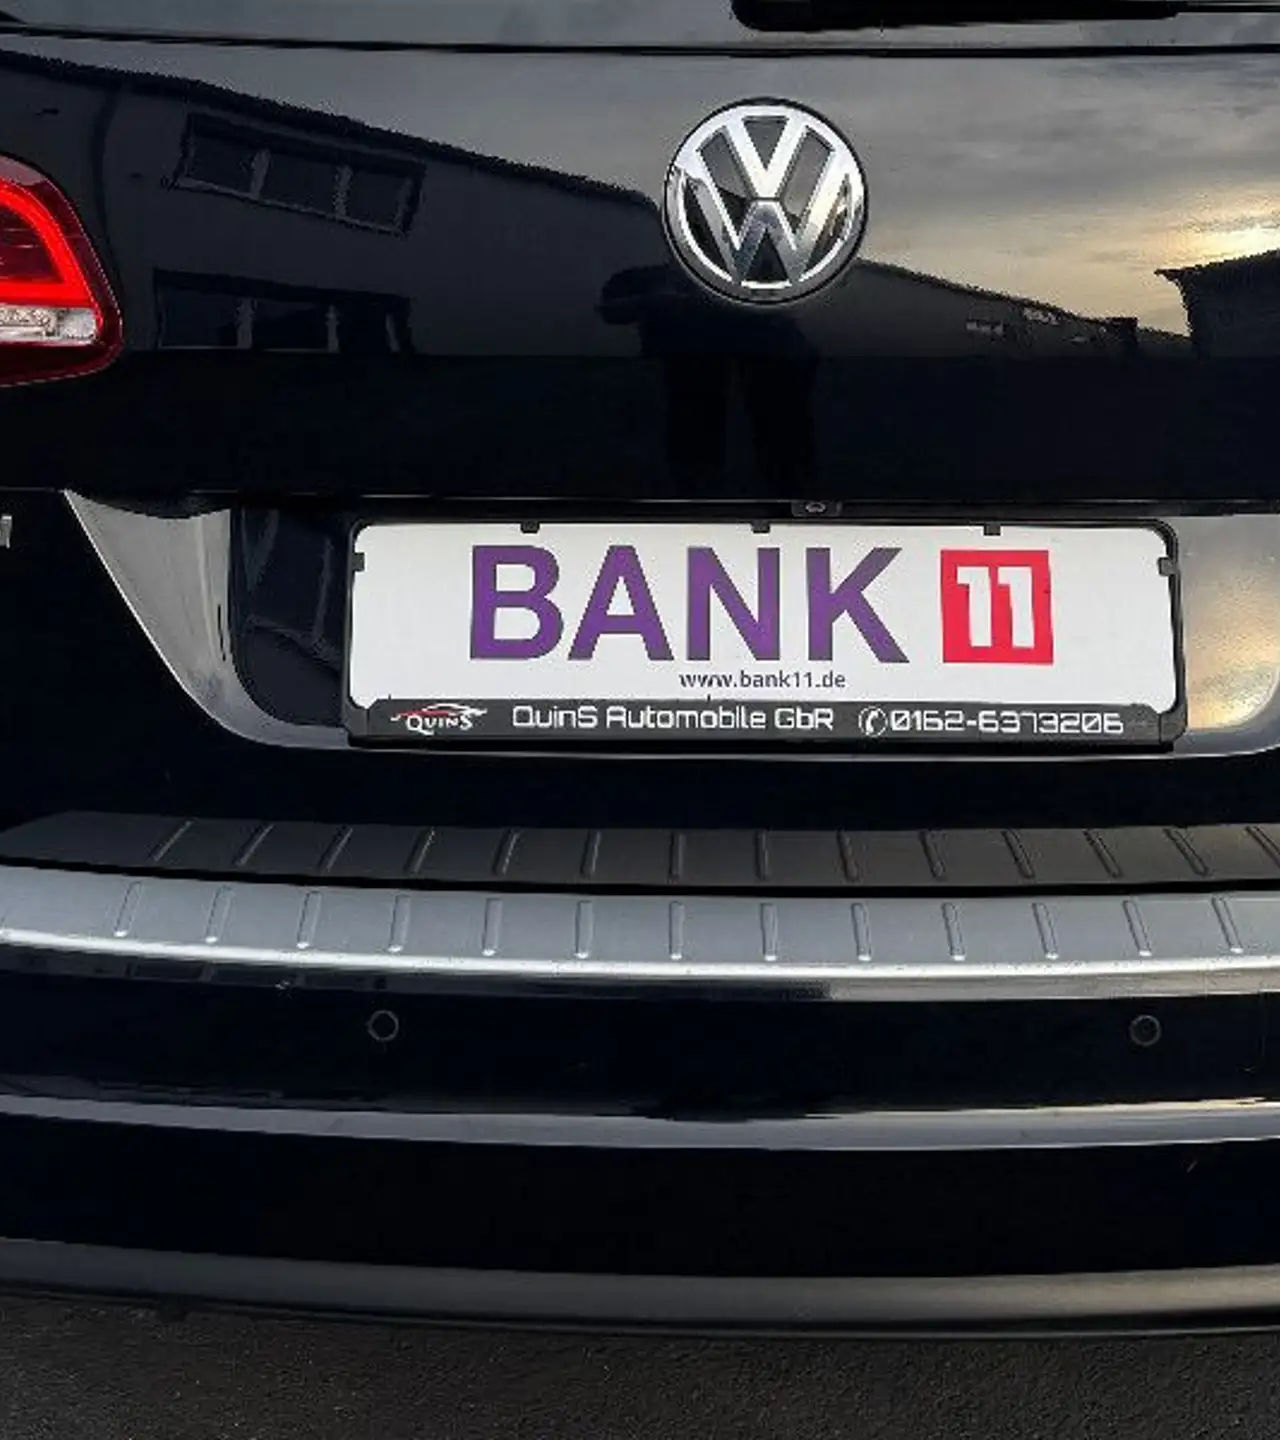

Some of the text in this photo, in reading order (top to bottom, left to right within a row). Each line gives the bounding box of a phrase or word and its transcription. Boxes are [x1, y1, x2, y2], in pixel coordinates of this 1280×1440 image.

[666, 101, 866, 300] VW
[469, 544, 1035, 664] BANK 11
[678, 669, 847, 689] www.bank11.de
[511, 704, 1125, 734] QuinS Automobile GbR 0162-6373206
